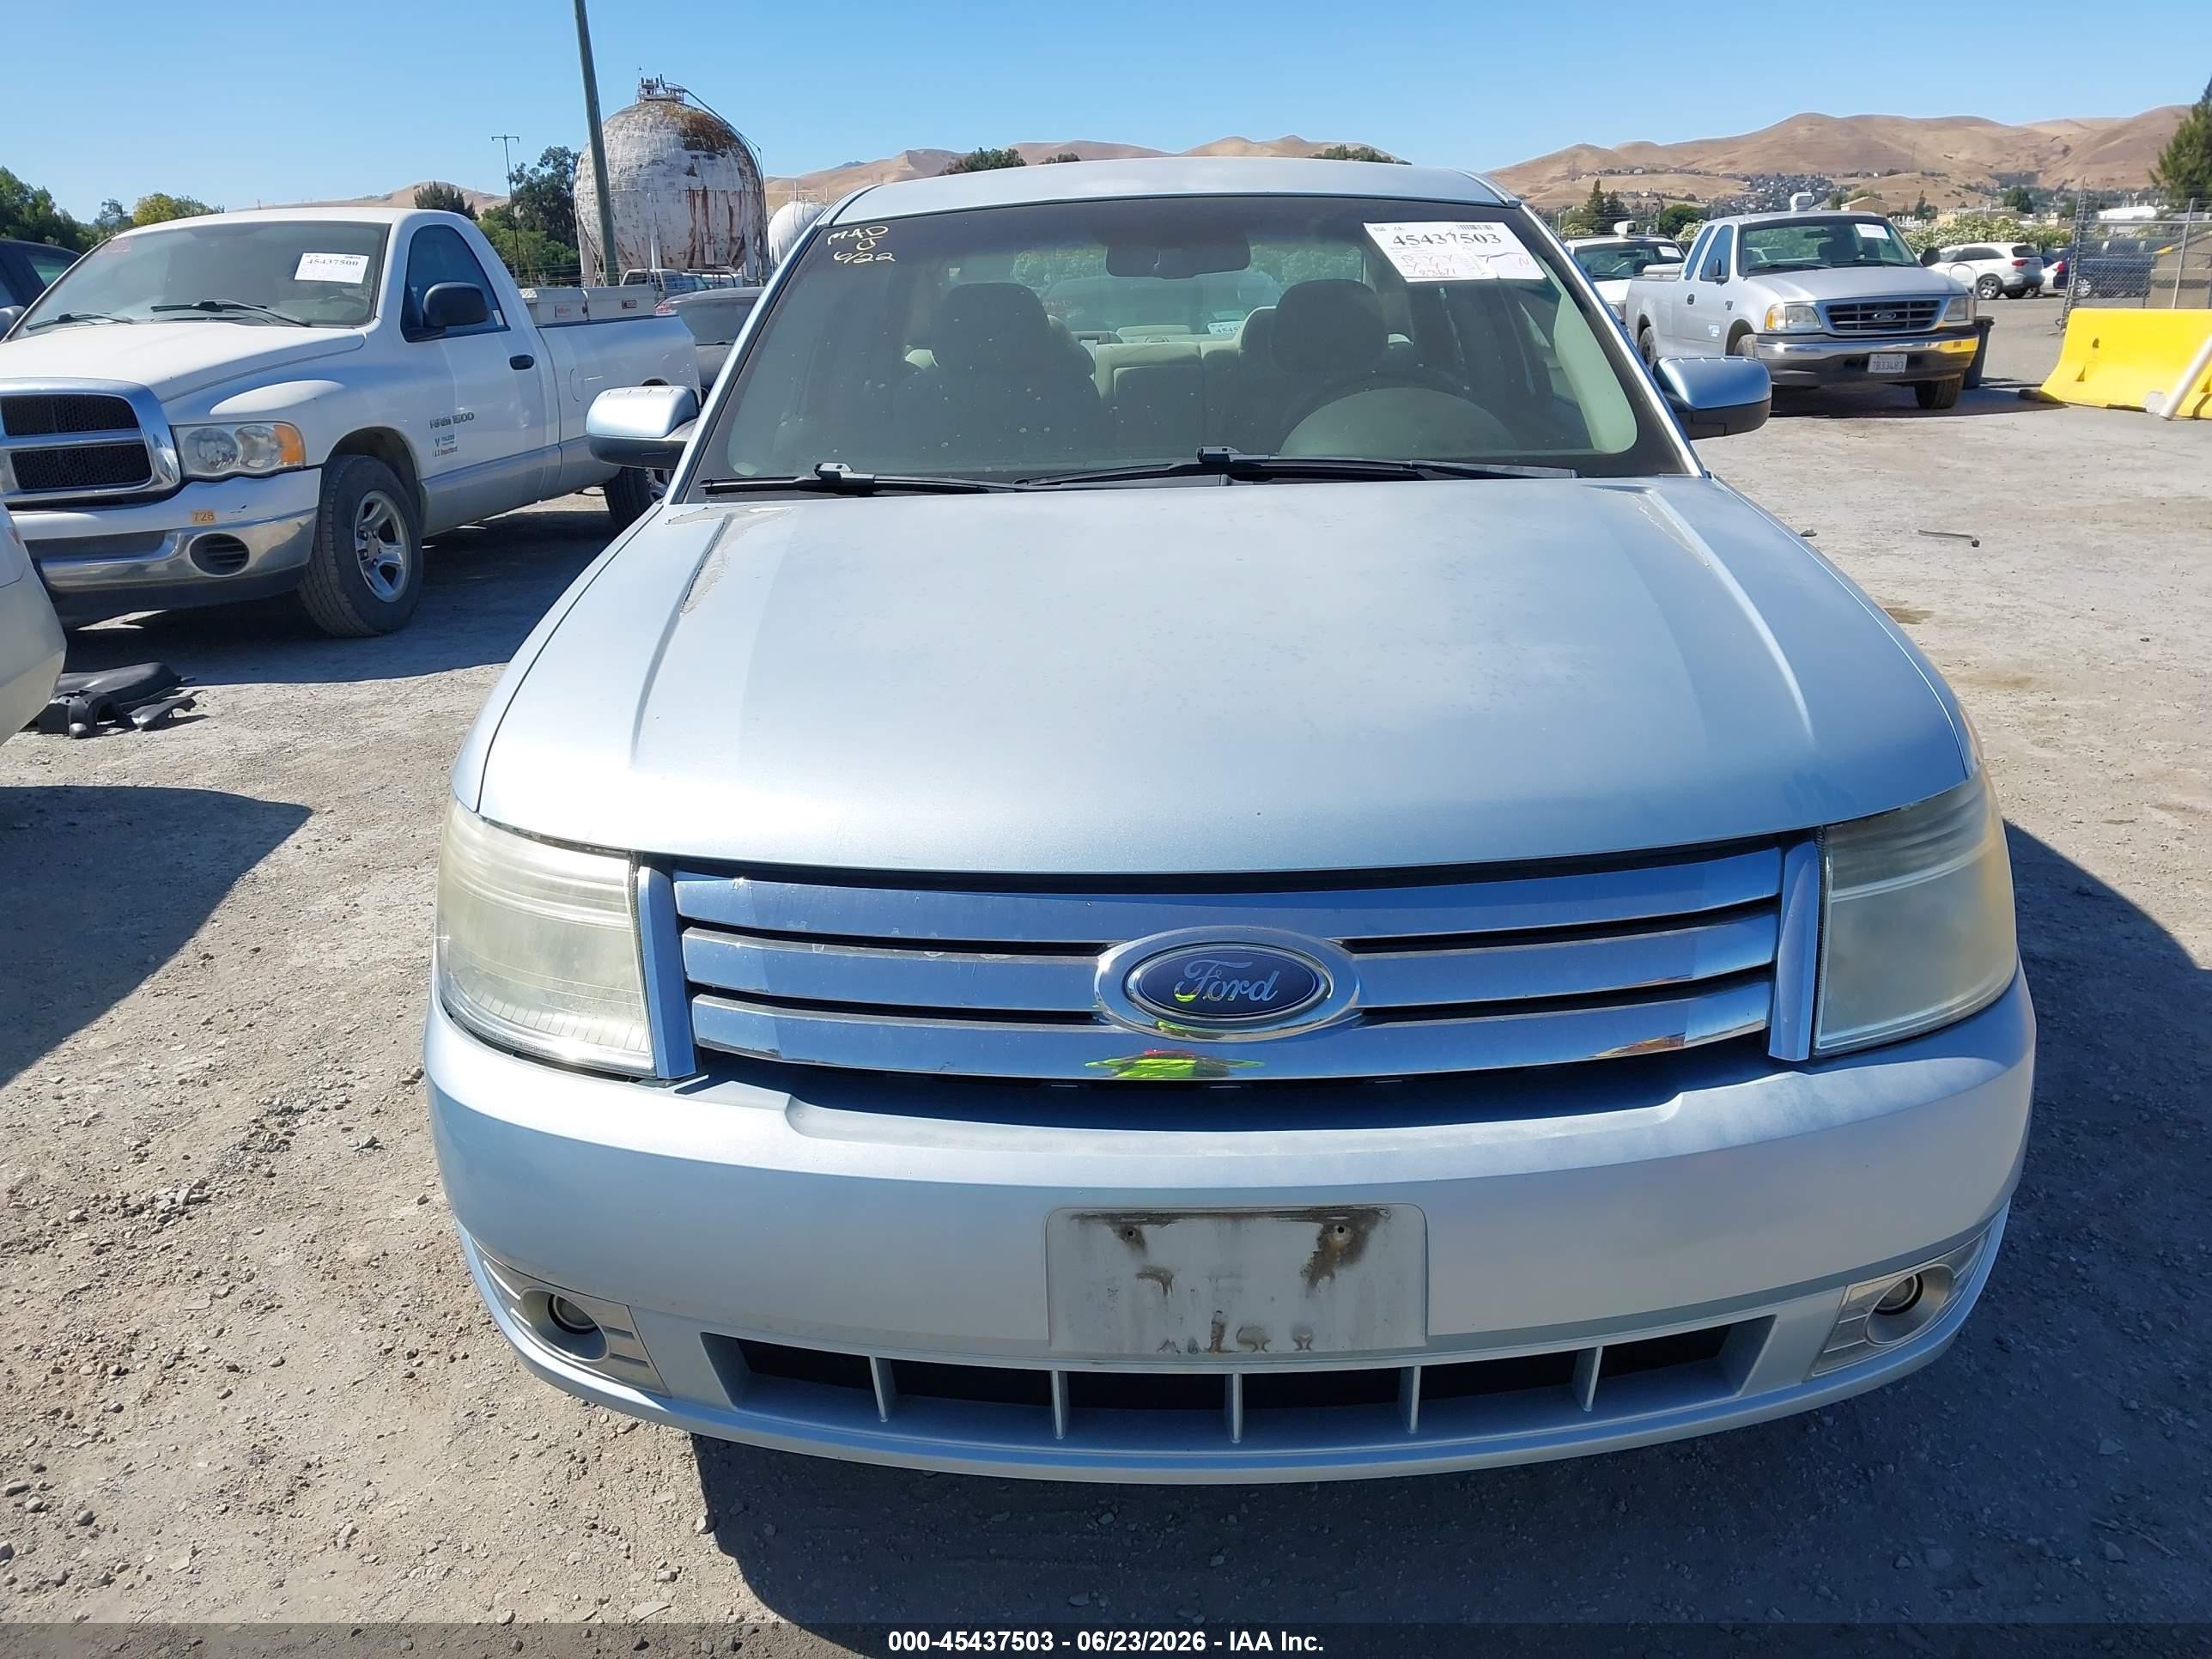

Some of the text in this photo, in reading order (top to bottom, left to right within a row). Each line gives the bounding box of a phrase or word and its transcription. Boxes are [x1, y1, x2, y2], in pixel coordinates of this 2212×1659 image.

[1393, 233, 1502, 246] 45437503
[833, 251, 896, 264] 6/22
[1174, 959, 1279, 1003] Ford
